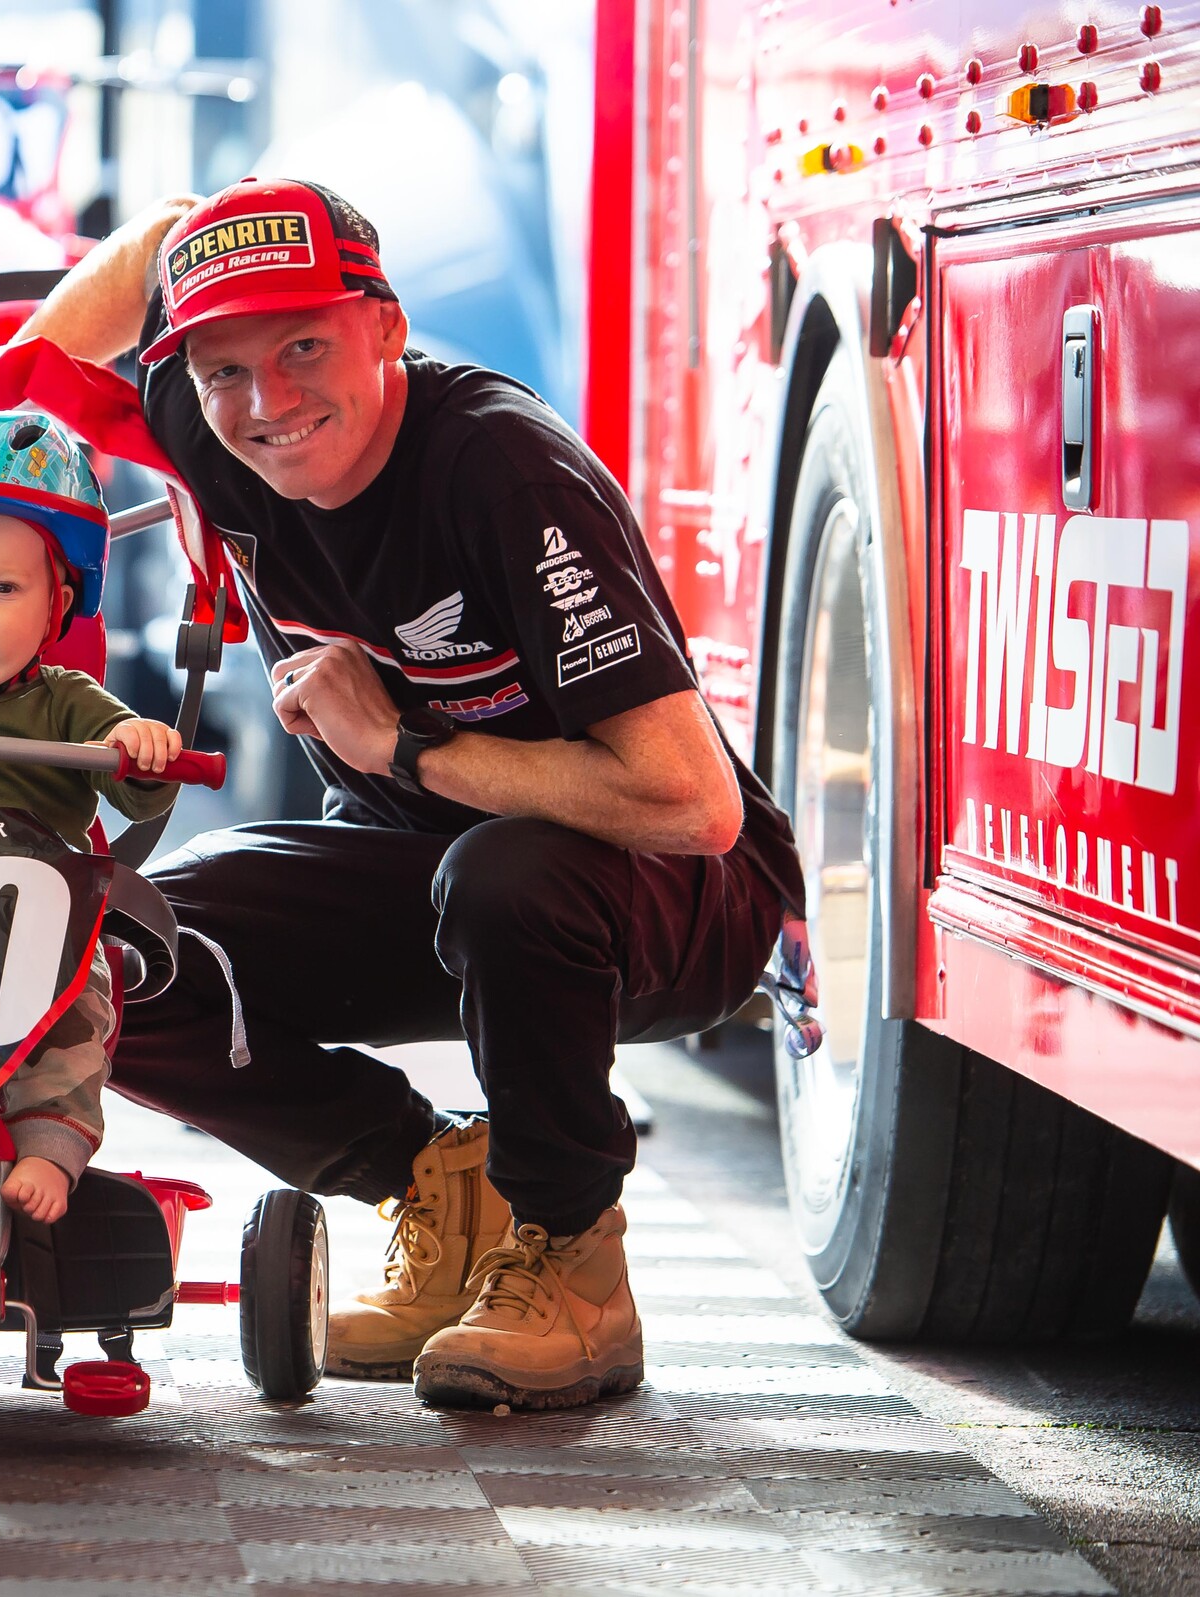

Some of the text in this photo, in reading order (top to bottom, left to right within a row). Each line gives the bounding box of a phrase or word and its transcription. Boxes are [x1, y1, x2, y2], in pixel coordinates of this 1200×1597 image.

[189, 218, 301, 265] PENRITE
[181, 262, 225, 293] Honda
[228, 250, 290, 270] Racing
[401, 640, 494, 661] HONDA
[594, 633, 634, 660] GENUINE
[958, 508, 1190, 797] TWISTED
[428, 682, 530, 722] HRC
[965, 797, 1179, 928] DEVELOPMENT
